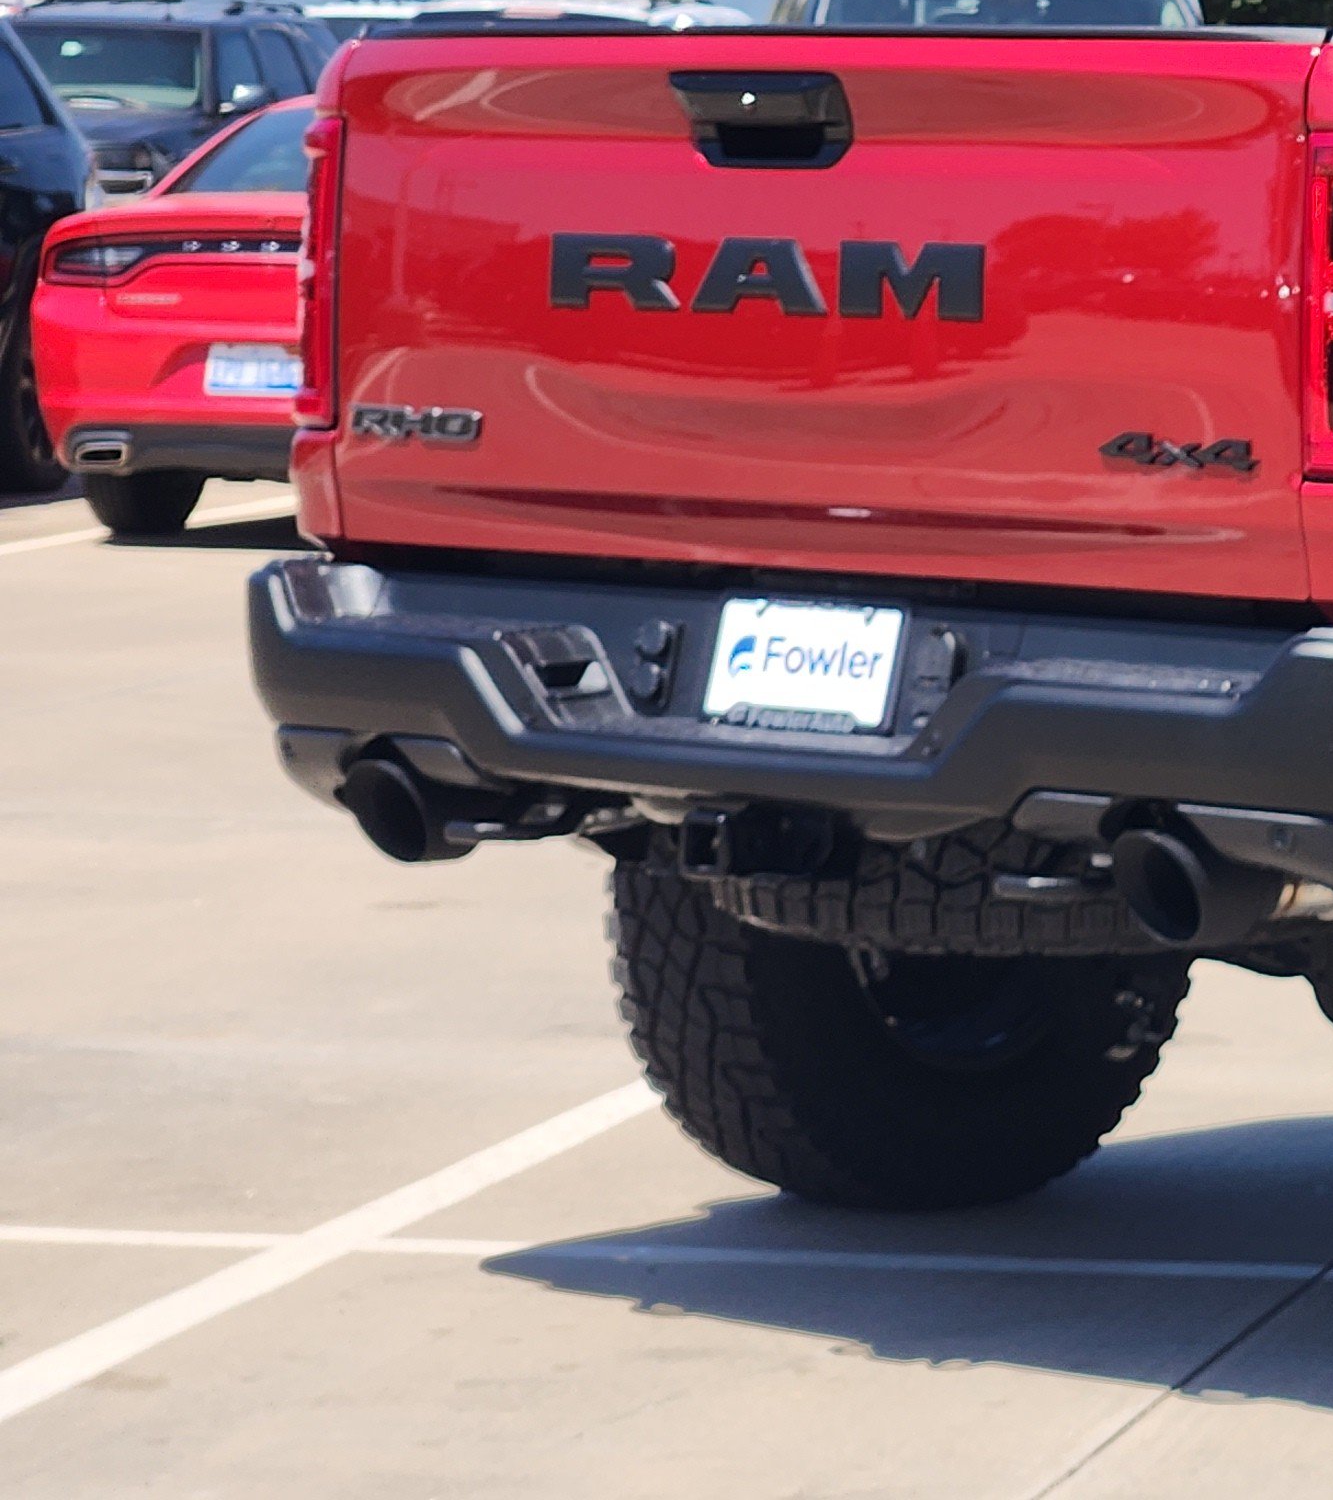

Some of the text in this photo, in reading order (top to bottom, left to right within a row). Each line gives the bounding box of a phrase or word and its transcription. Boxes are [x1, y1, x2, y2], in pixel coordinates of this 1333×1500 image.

[549, 232, 986, 322] RAM
[351, 403, 482, 443] RHO
[763, 636, 883, 679] Fowler
